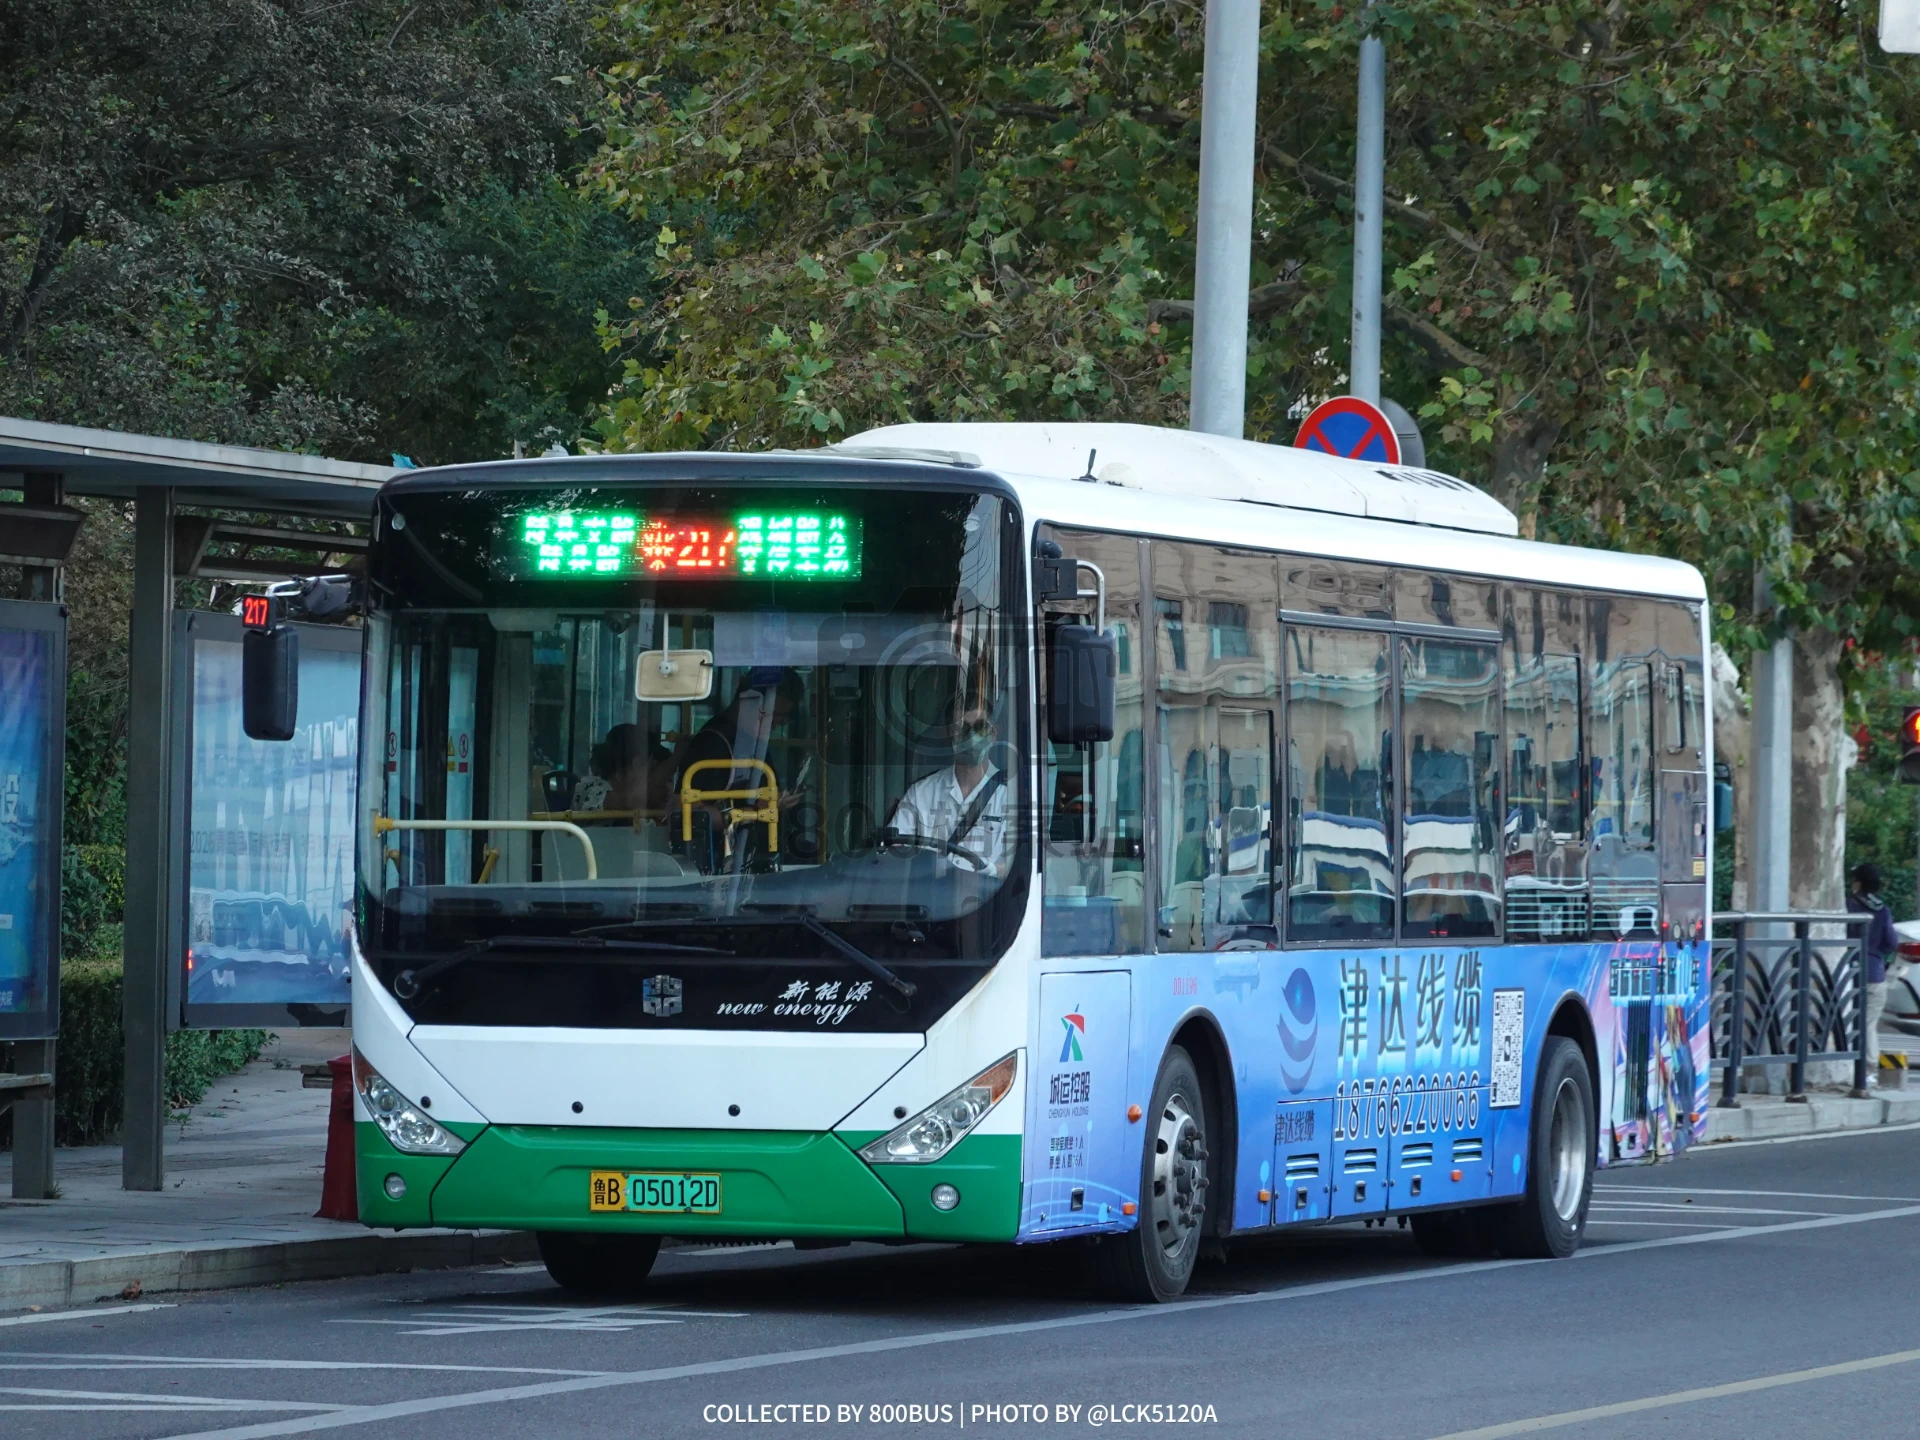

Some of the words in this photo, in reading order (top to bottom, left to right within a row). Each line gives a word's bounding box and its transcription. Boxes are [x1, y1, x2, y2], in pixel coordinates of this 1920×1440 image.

[244, 598, 268, 625] 217
[778, 980, 873, 1002] 新能源
[1338, 951, 1483, 1060] 津达线缆
[716, 1001, 768, 1015] new
[773, 1001, 857, 1025] energy
[1049, 1071, 1091, 1105] 城运控股
[1071, 1106, 1090, 1117] HOLDING
[1334, 1070, 1480, 1142] 18766220066
[1275, 1109, 1315, 1145] 津达线缆
